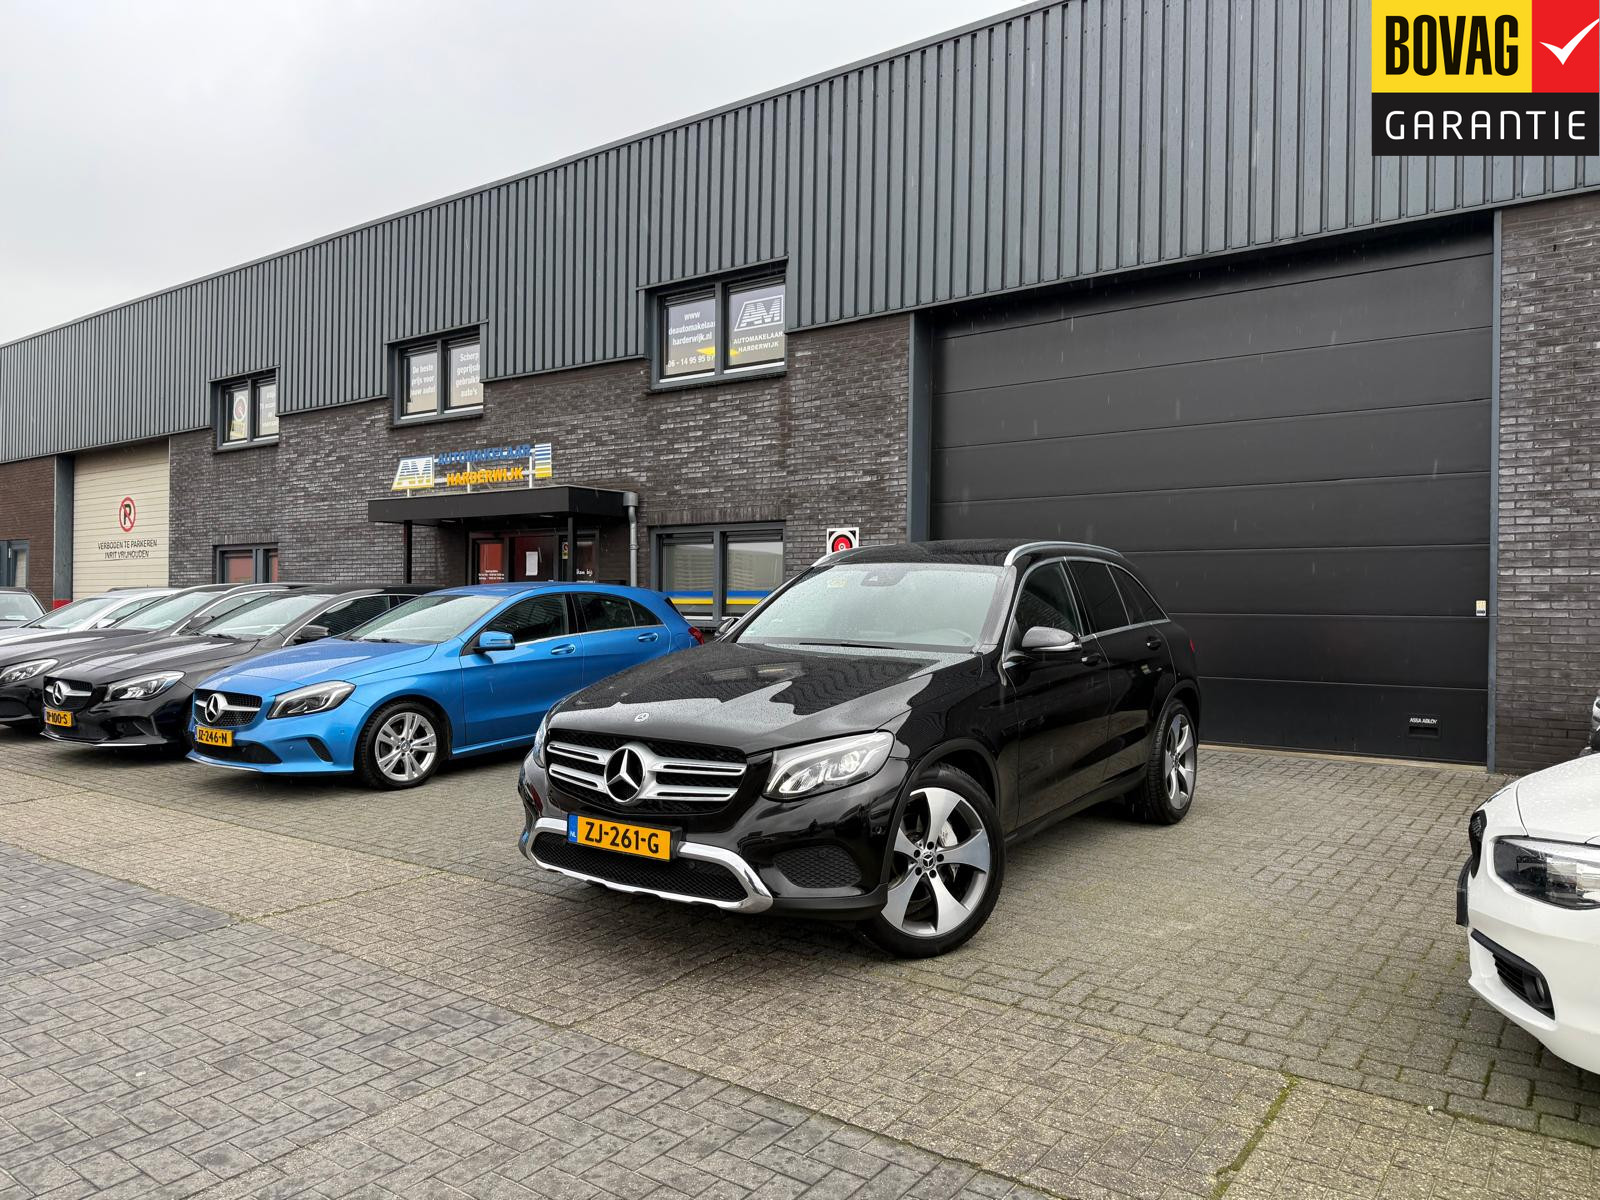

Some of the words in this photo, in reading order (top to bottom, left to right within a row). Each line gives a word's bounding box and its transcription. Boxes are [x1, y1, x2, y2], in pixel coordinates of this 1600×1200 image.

[684, 312, 700, 320] www
[672, 331, 712, 345] harderwijk.nl
[733, 331, 784, 344] AUTOMAKELAAR
[738, 341, 779, 352] HARDERWIJK
[420, 364, 433, 373] beste
[423, 375, 435, 383] voor
[437, 444, 531, 464] AUTOMAKELAAR
[446, 466, 524, 486] HARDERWIJK
[98, 542, 123, 550] VERBODEN
[124, 540, 130, 548] TE
[131, 540, 157, 548] PARKEREN
[198, 729, 227, 744] JZ-246-N
[584, 822, 659, 854] ZJ-261-G
